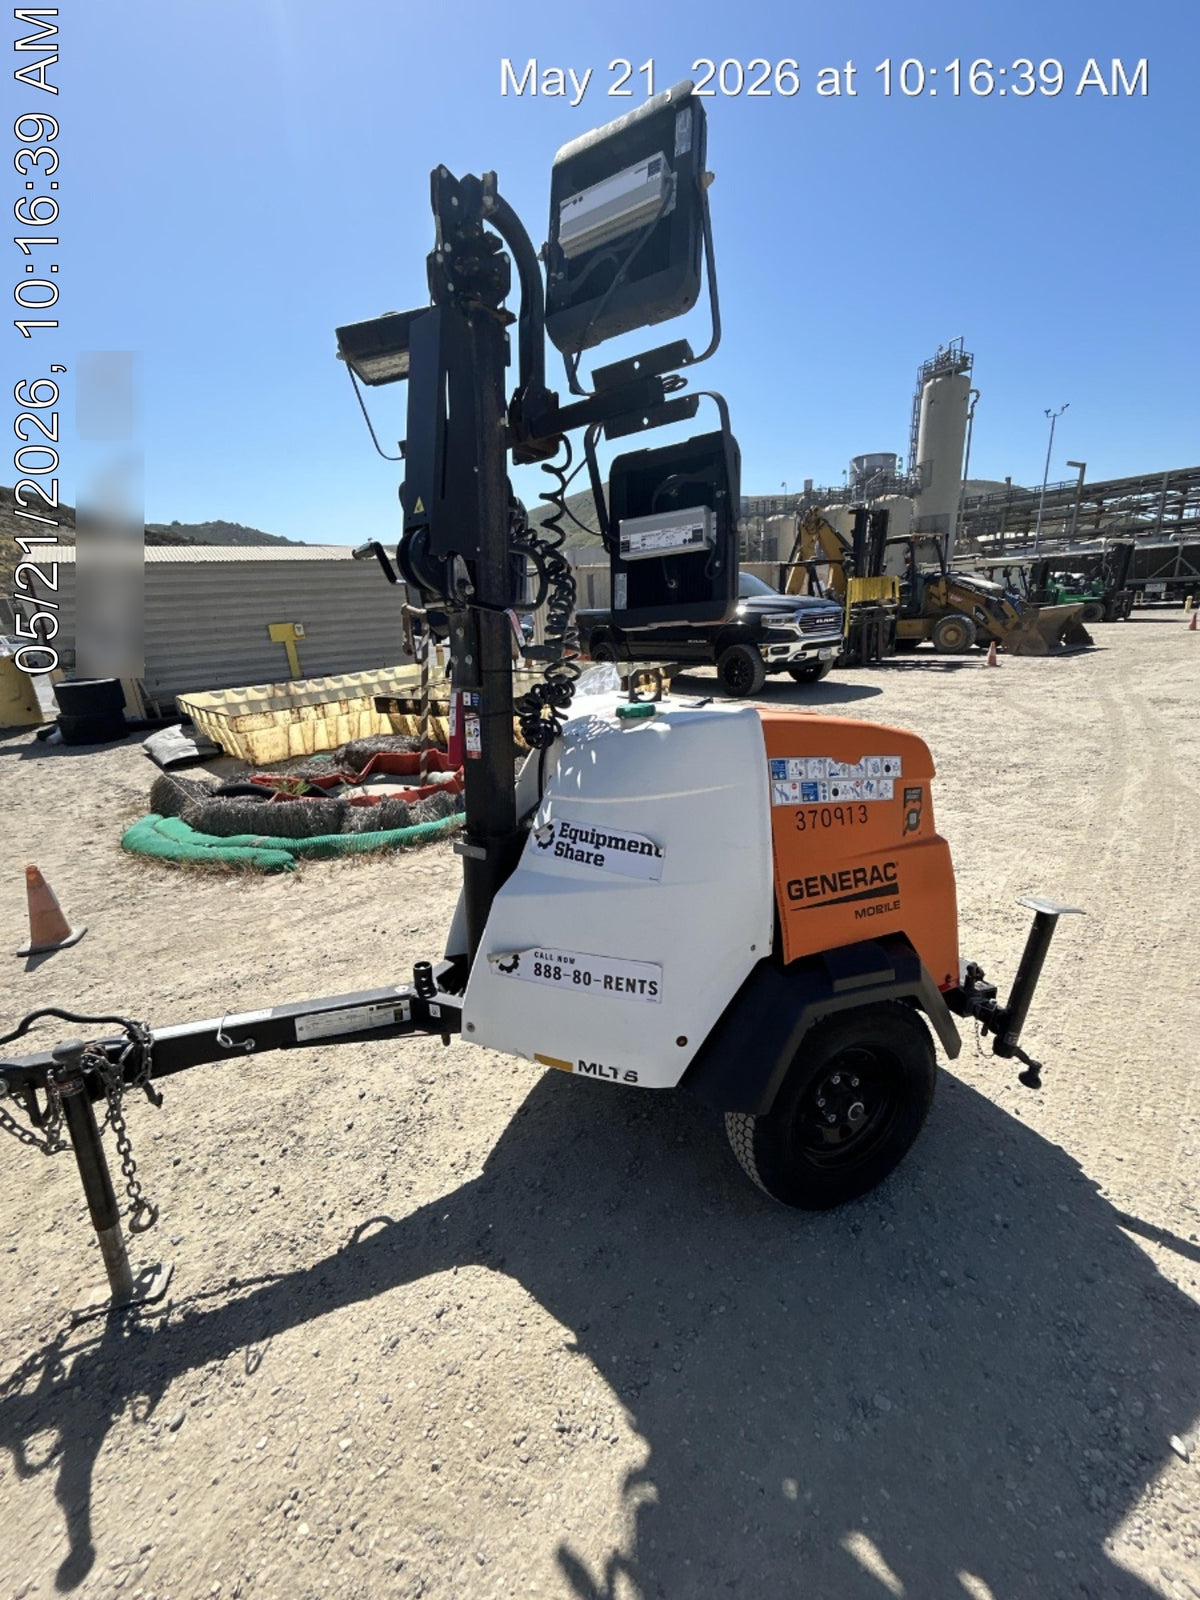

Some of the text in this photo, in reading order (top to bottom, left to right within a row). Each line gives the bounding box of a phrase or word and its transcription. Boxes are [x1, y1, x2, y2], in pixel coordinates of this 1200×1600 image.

[796, 804, 868, 832] 370913
[557, 821, 663, 858] Equipment
[553, 841, 605, 868] Share
[786, 862, 898, 901] GENERAC
[854, 900, 901, 919] MOBILE
[534, 951, 576, 965] CALL NOW
[533, 962, 659, 996] 888-80-RENTS
